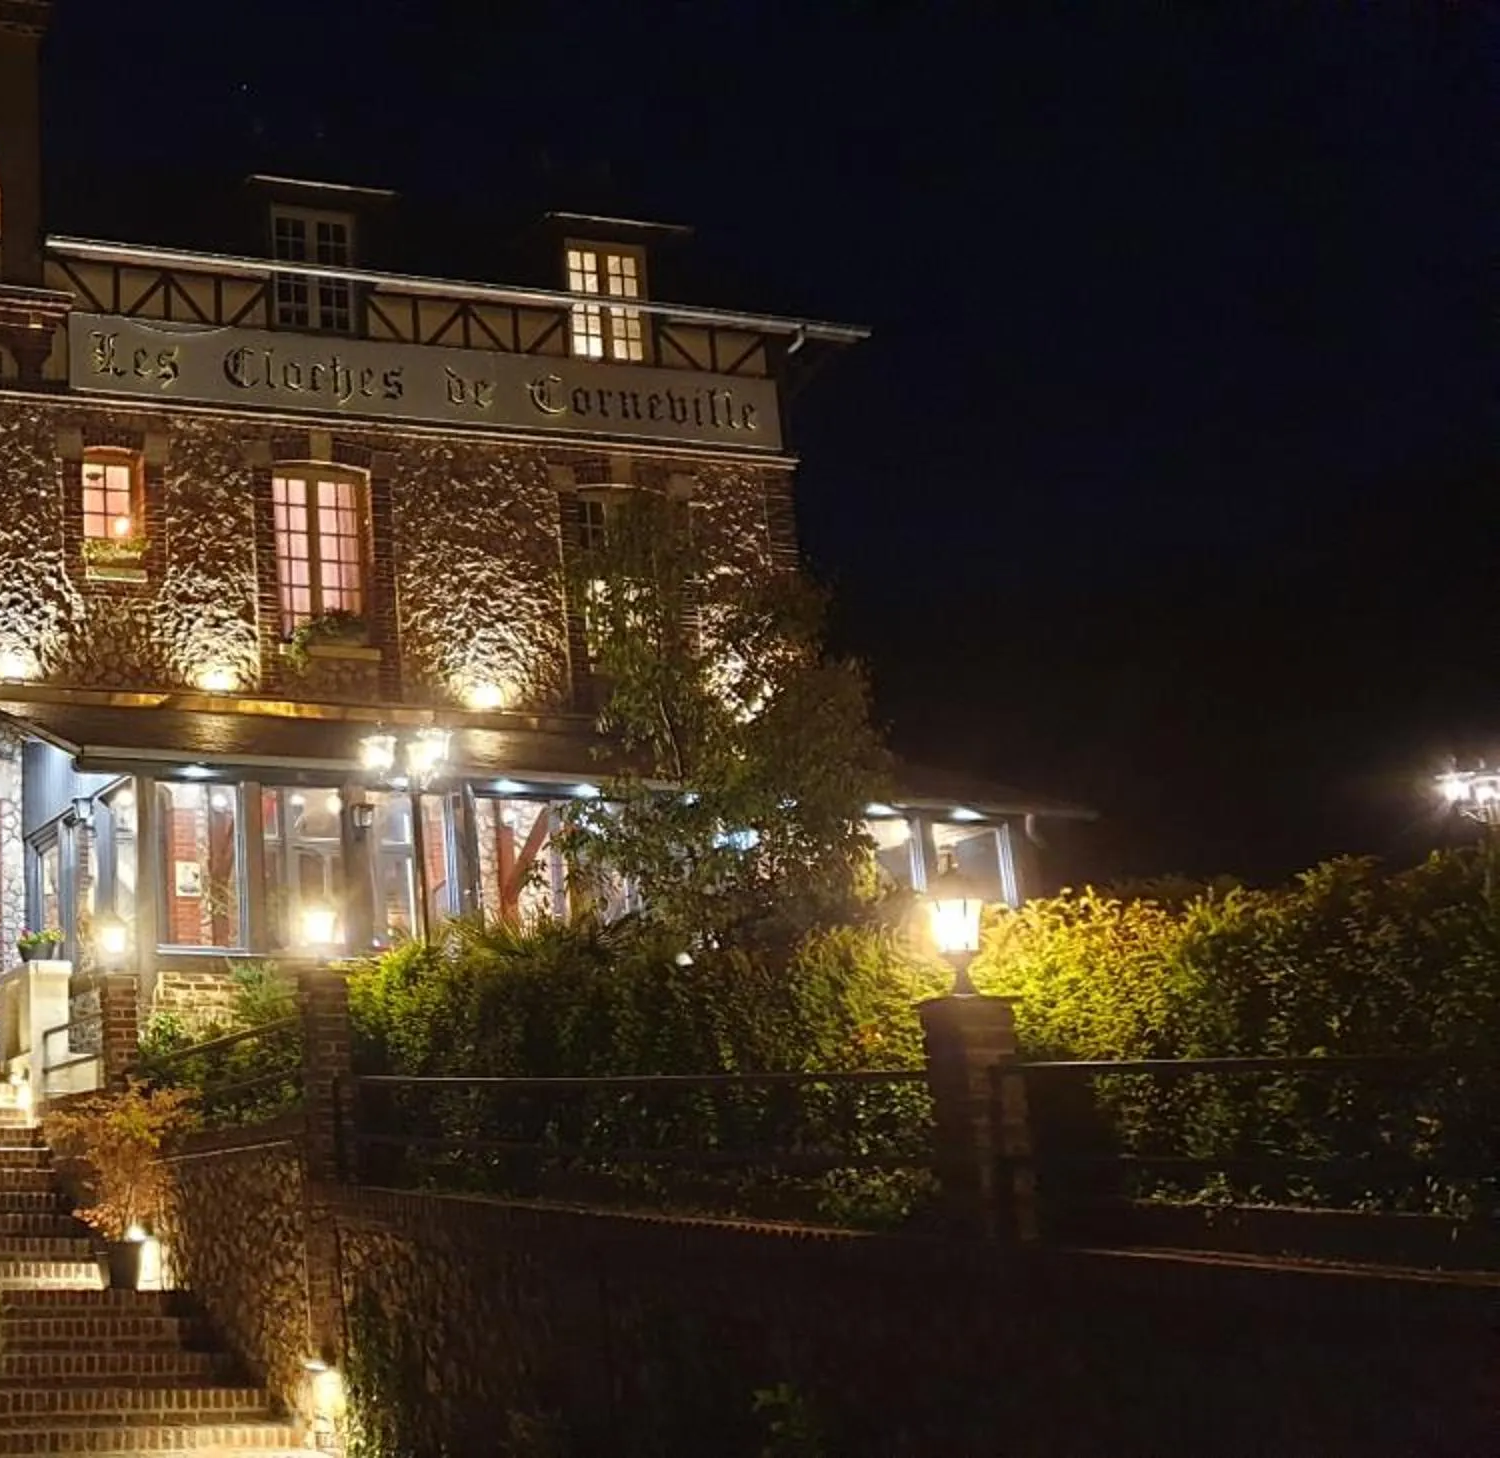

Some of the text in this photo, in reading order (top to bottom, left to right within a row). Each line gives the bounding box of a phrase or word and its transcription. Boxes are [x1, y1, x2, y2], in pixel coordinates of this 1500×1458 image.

[90, 331, 757, 431] Les Cloches de Corneville
